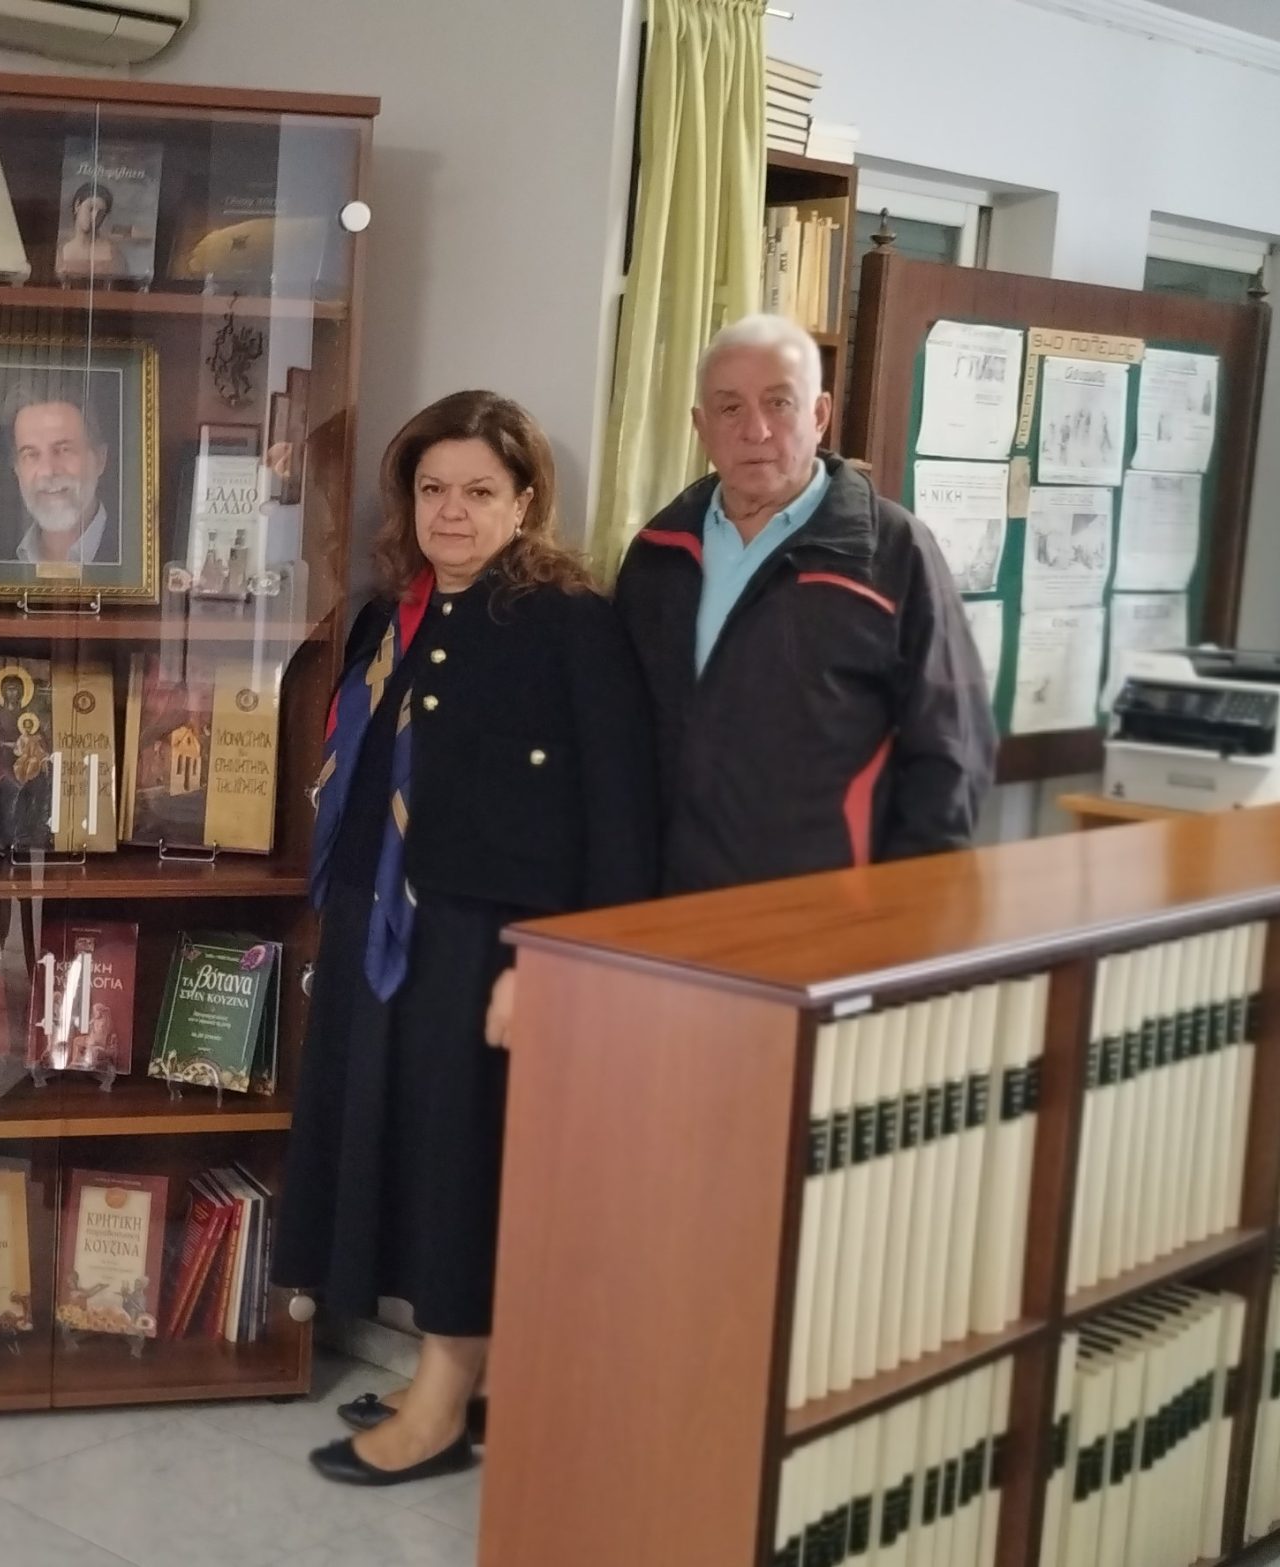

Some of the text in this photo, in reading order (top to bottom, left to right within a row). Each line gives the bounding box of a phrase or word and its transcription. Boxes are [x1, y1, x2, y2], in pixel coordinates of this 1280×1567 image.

[182, 964, 254, 996] ΤΑ βότανα
[207, 993, 249, 1009] ΚΟΥΖΙΝΑ
[86, 1212, 142, 1231] ΚΡΗΤΙΚΗ
